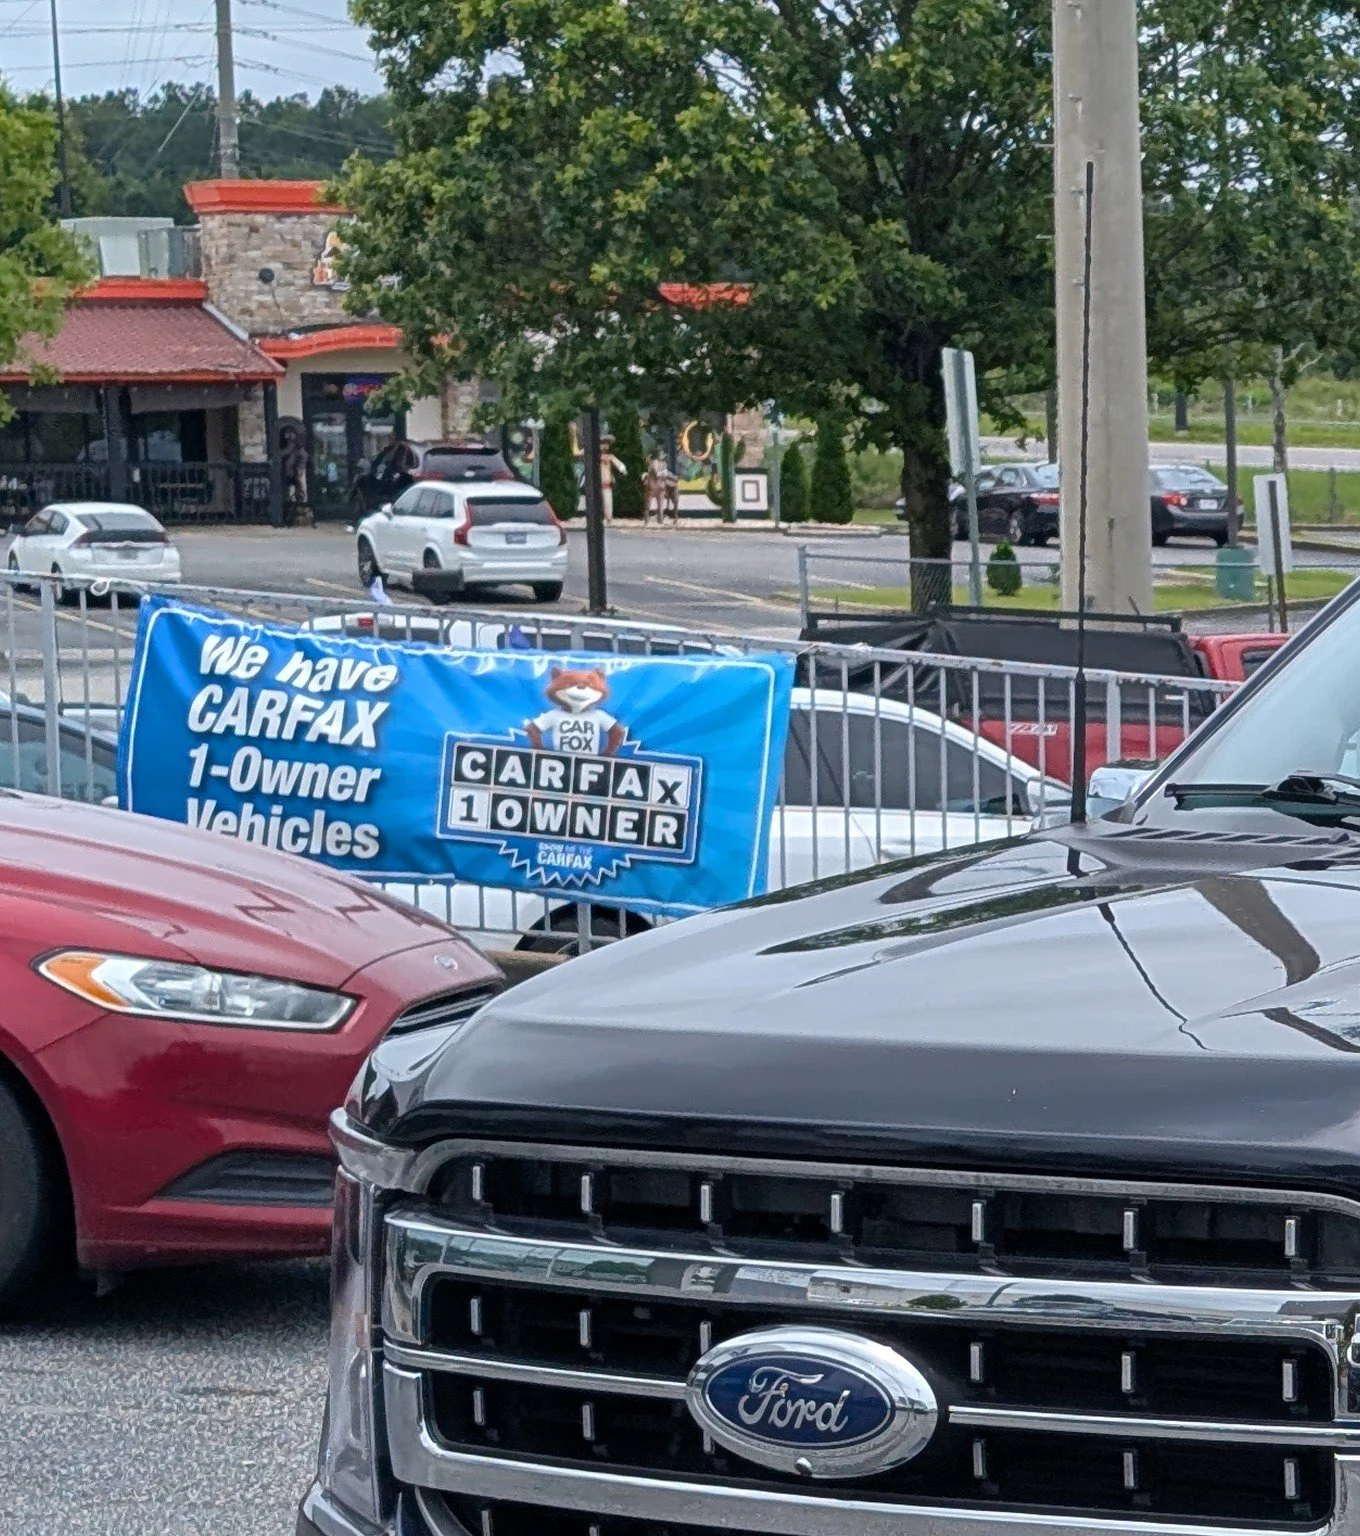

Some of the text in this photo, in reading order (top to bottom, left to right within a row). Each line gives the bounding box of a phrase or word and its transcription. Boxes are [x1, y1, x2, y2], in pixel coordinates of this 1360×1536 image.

[200, 634, 399, 692] We have
[188, 684, 390, 748] CARFAX
[559, 720, 595, 735] CAR
[559, 736, 593, 752] FOX
[188, 743, 382, 803] 1-Owner
[461, 750, 683, 806] CARFAX
[186, 798, 380, 859] Vehicles
[459, 794, 678, 846] 1 OWNER
[537, 850, 593, 871] CARFAX
[738, 1365, 851, 1433] Ford
